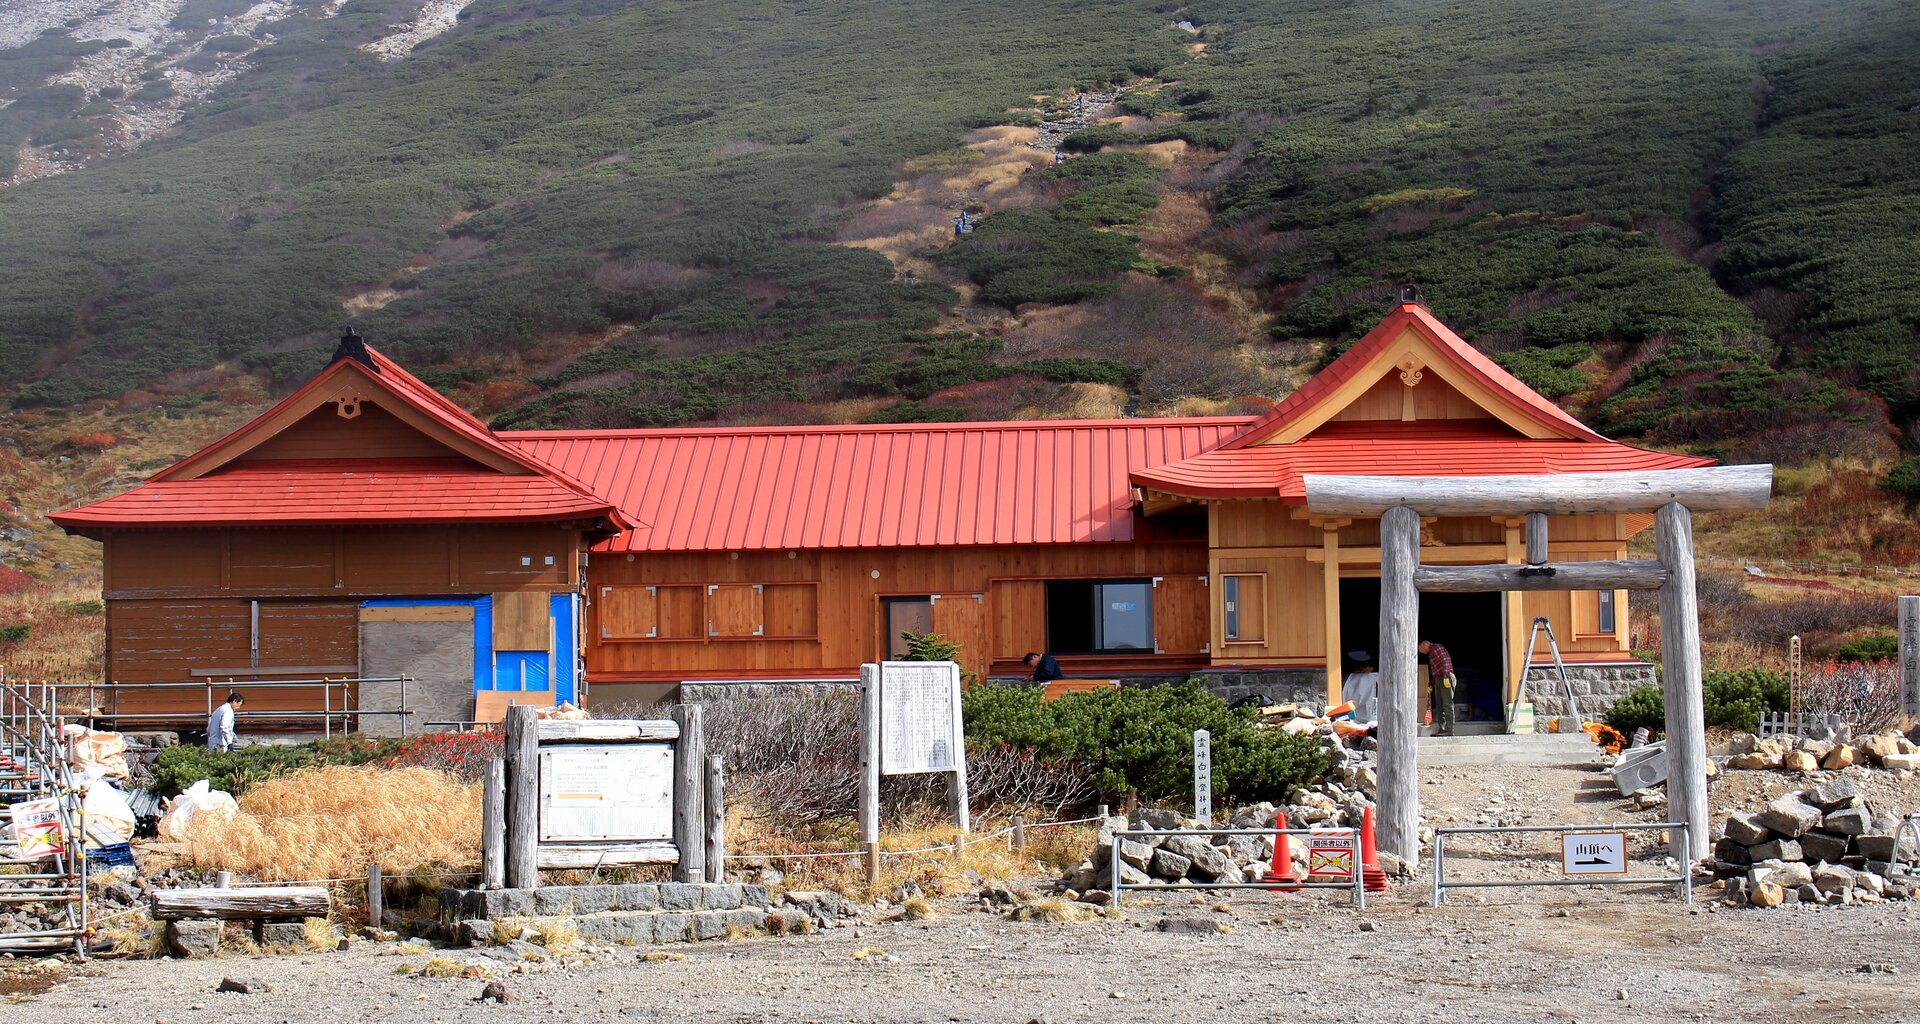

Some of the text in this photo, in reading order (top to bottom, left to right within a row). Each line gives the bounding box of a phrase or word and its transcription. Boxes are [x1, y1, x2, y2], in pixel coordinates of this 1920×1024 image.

[1313, 840, 1350, 848] 関係者以外
[1576, 843, 1613, 855] 山頂へ
